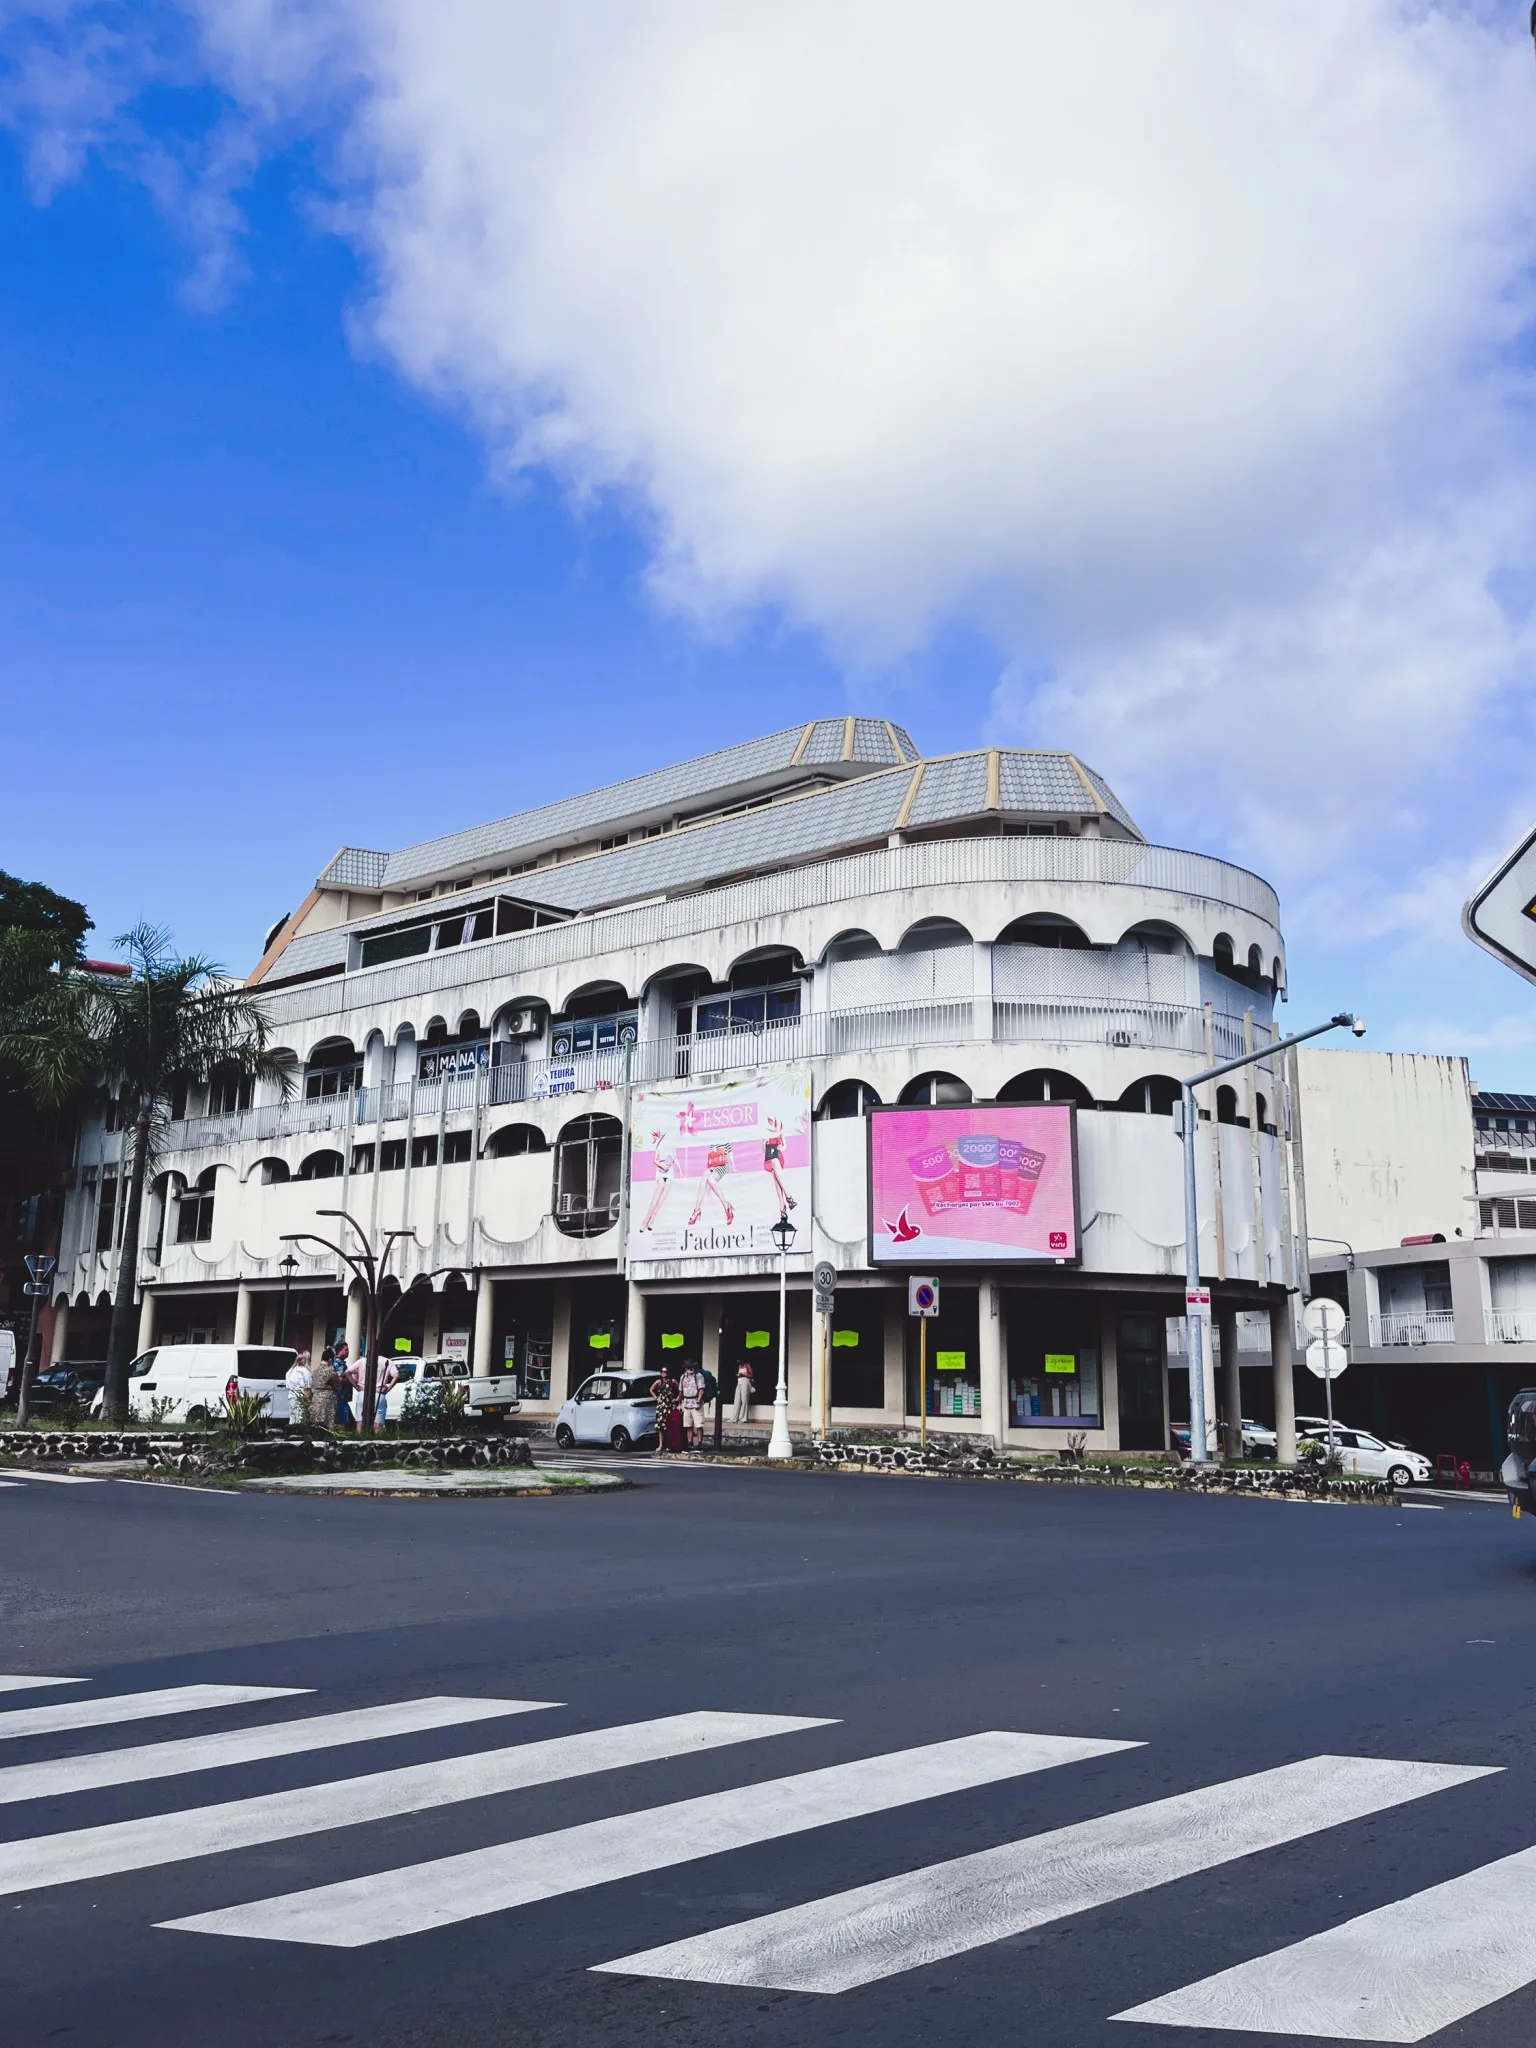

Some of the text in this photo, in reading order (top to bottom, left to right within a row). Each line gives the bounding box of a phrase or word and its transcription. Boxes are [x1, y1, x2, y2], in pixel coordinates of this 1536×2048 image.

[550, 1067, 575, 1080] TEUIRA
[549, 1081, 575, 1094] TATTOO
[703, 1106, 754, 1128] ESSOR
[750, 1224, 754, 1248] !
[820, 1271, 832, 1285] 30
